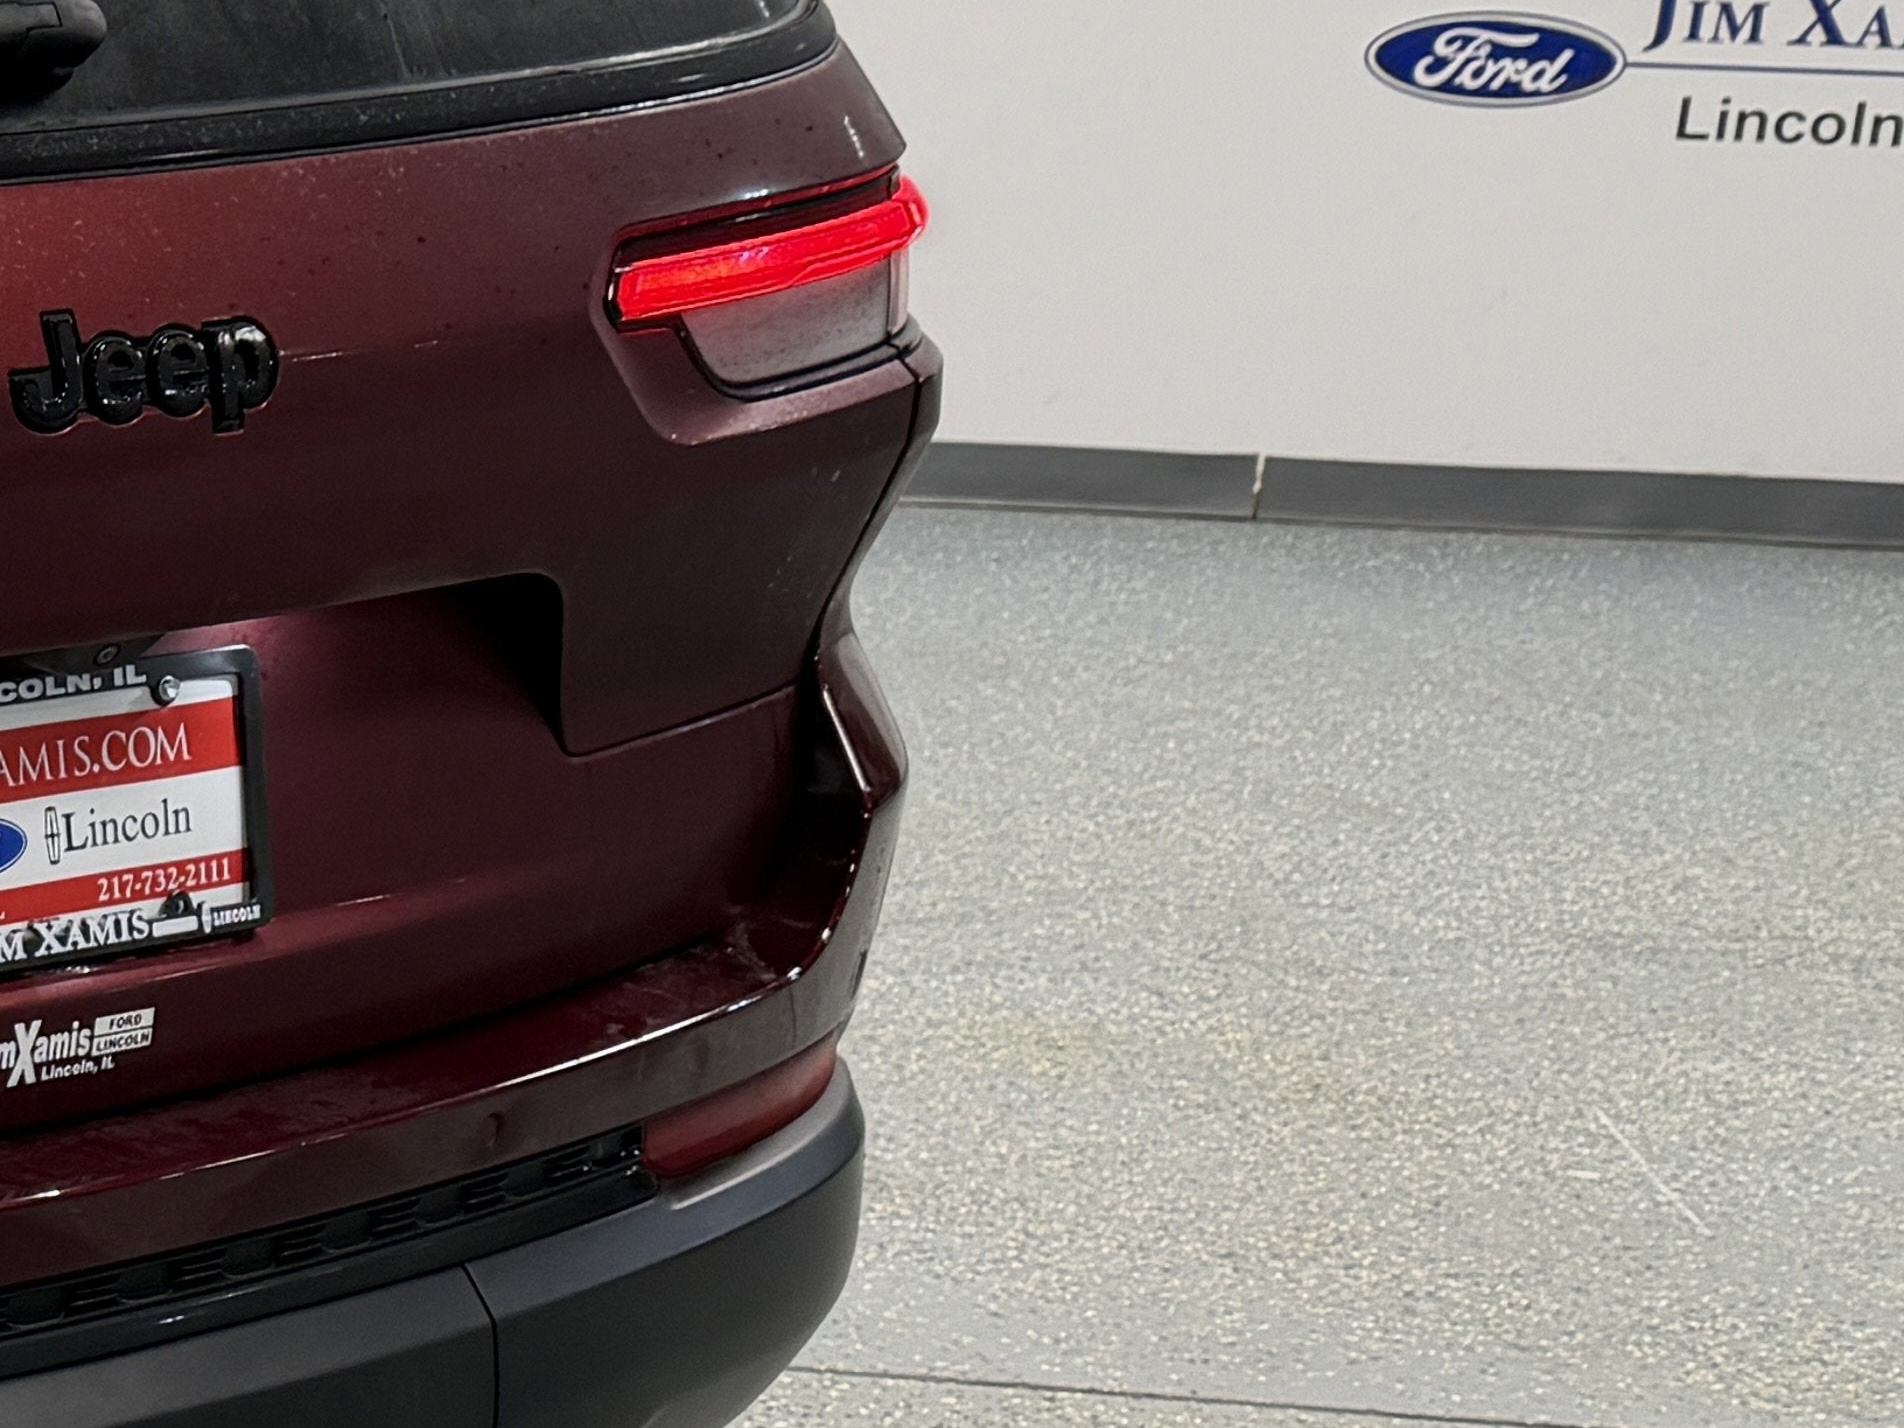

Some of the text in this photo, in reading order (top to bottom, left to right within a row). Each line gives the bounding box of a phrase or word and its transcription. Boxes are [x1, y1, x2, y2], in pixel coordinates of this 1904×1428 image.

[1675, 96, 1904, 147] Lincoln
[8, 309, 280, 435] Jeep
[113, 664, 147, 686] IL
[62, 798, 192, 853] Lincoln
[97, 857, 231, 902] 217-732-2111
[33, 907, 150, 958] XAMIS
[96, 1030, 151, 1052] LINCOLN
